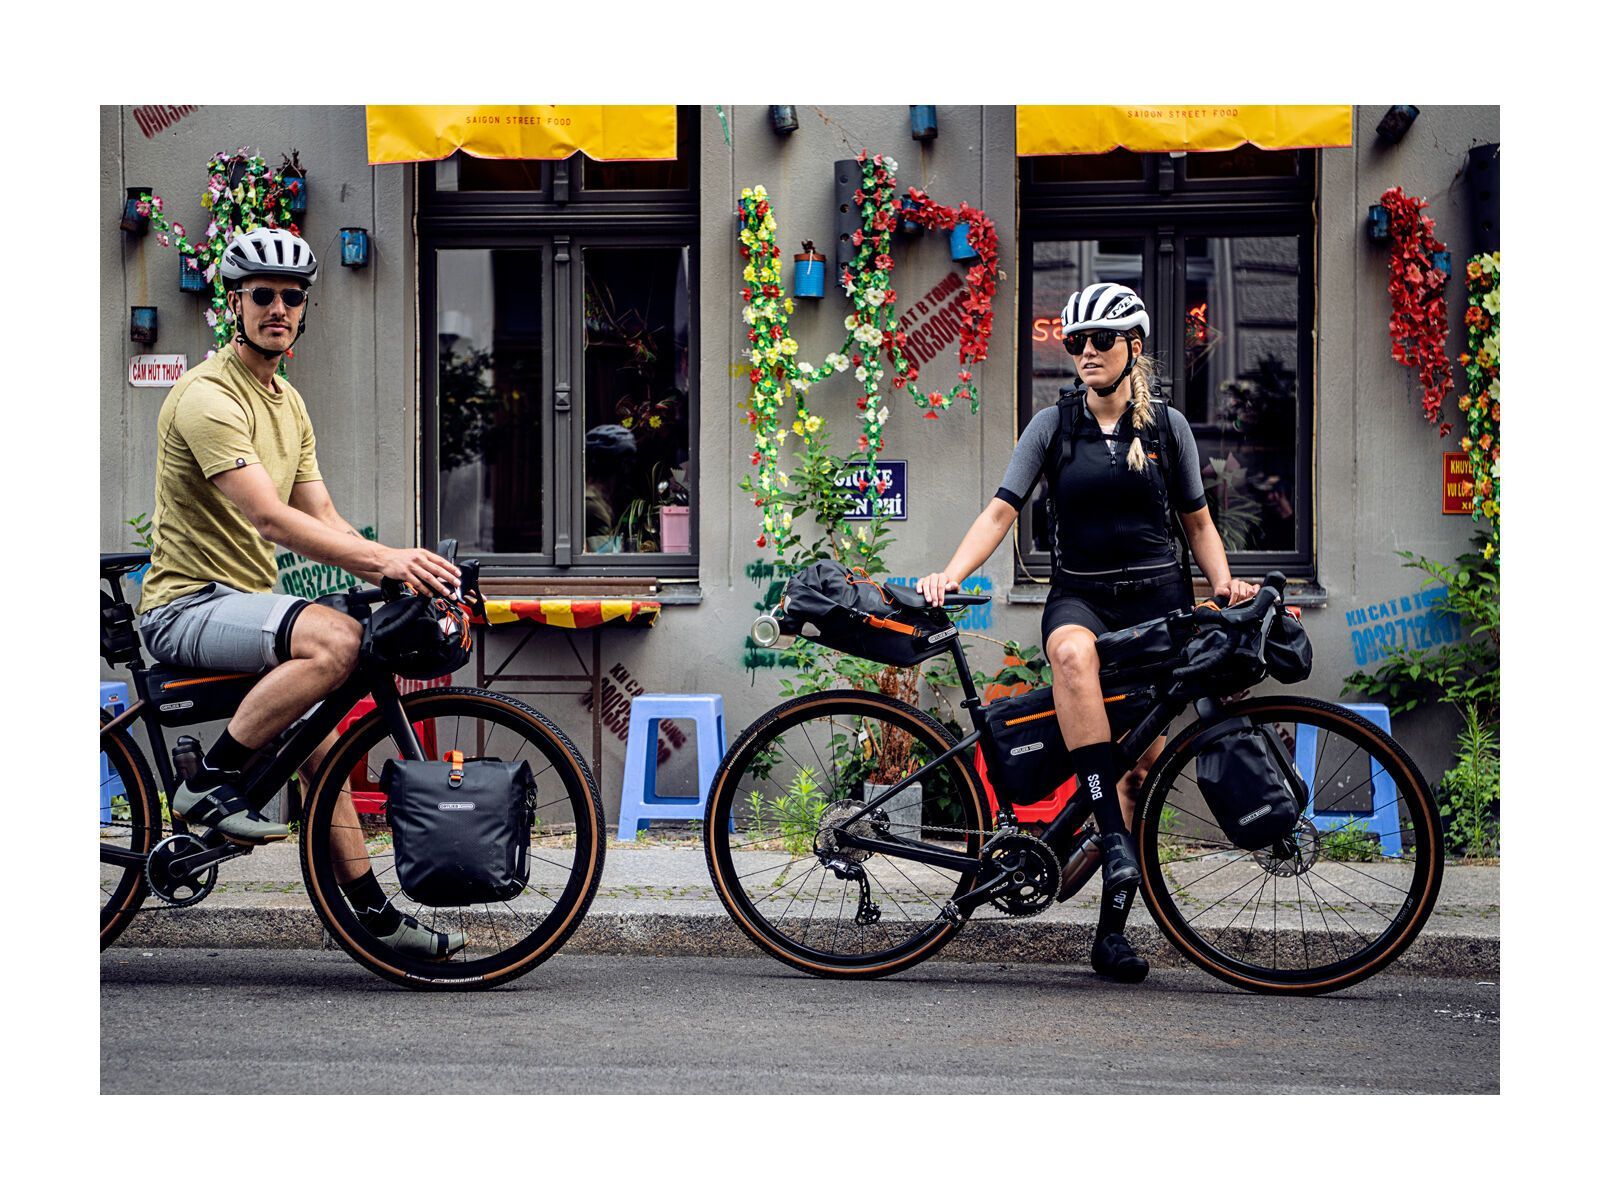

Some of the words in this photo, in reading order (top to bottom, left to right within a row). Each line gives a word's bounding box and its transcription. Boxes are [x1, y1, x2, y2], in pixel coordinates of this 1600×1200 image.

[466, 116, 500, 124] SAIGON
[506, 117, 541, 125] STREET
[547, 118, 571, 126] FOOD
[1127, 110, 1162, 119] SAIGON
[1169, 110, 1206, 119] STREET
[1213, 109, 1239, 118] FOOD
[1345, 608, 1368, 626] KH
[1368, 599, 1398, 621] CAT
[609, 663, 631, 684] KH
[625, 680, 645, 697] CA
[1087, 773, 1103, 800] BOSS
